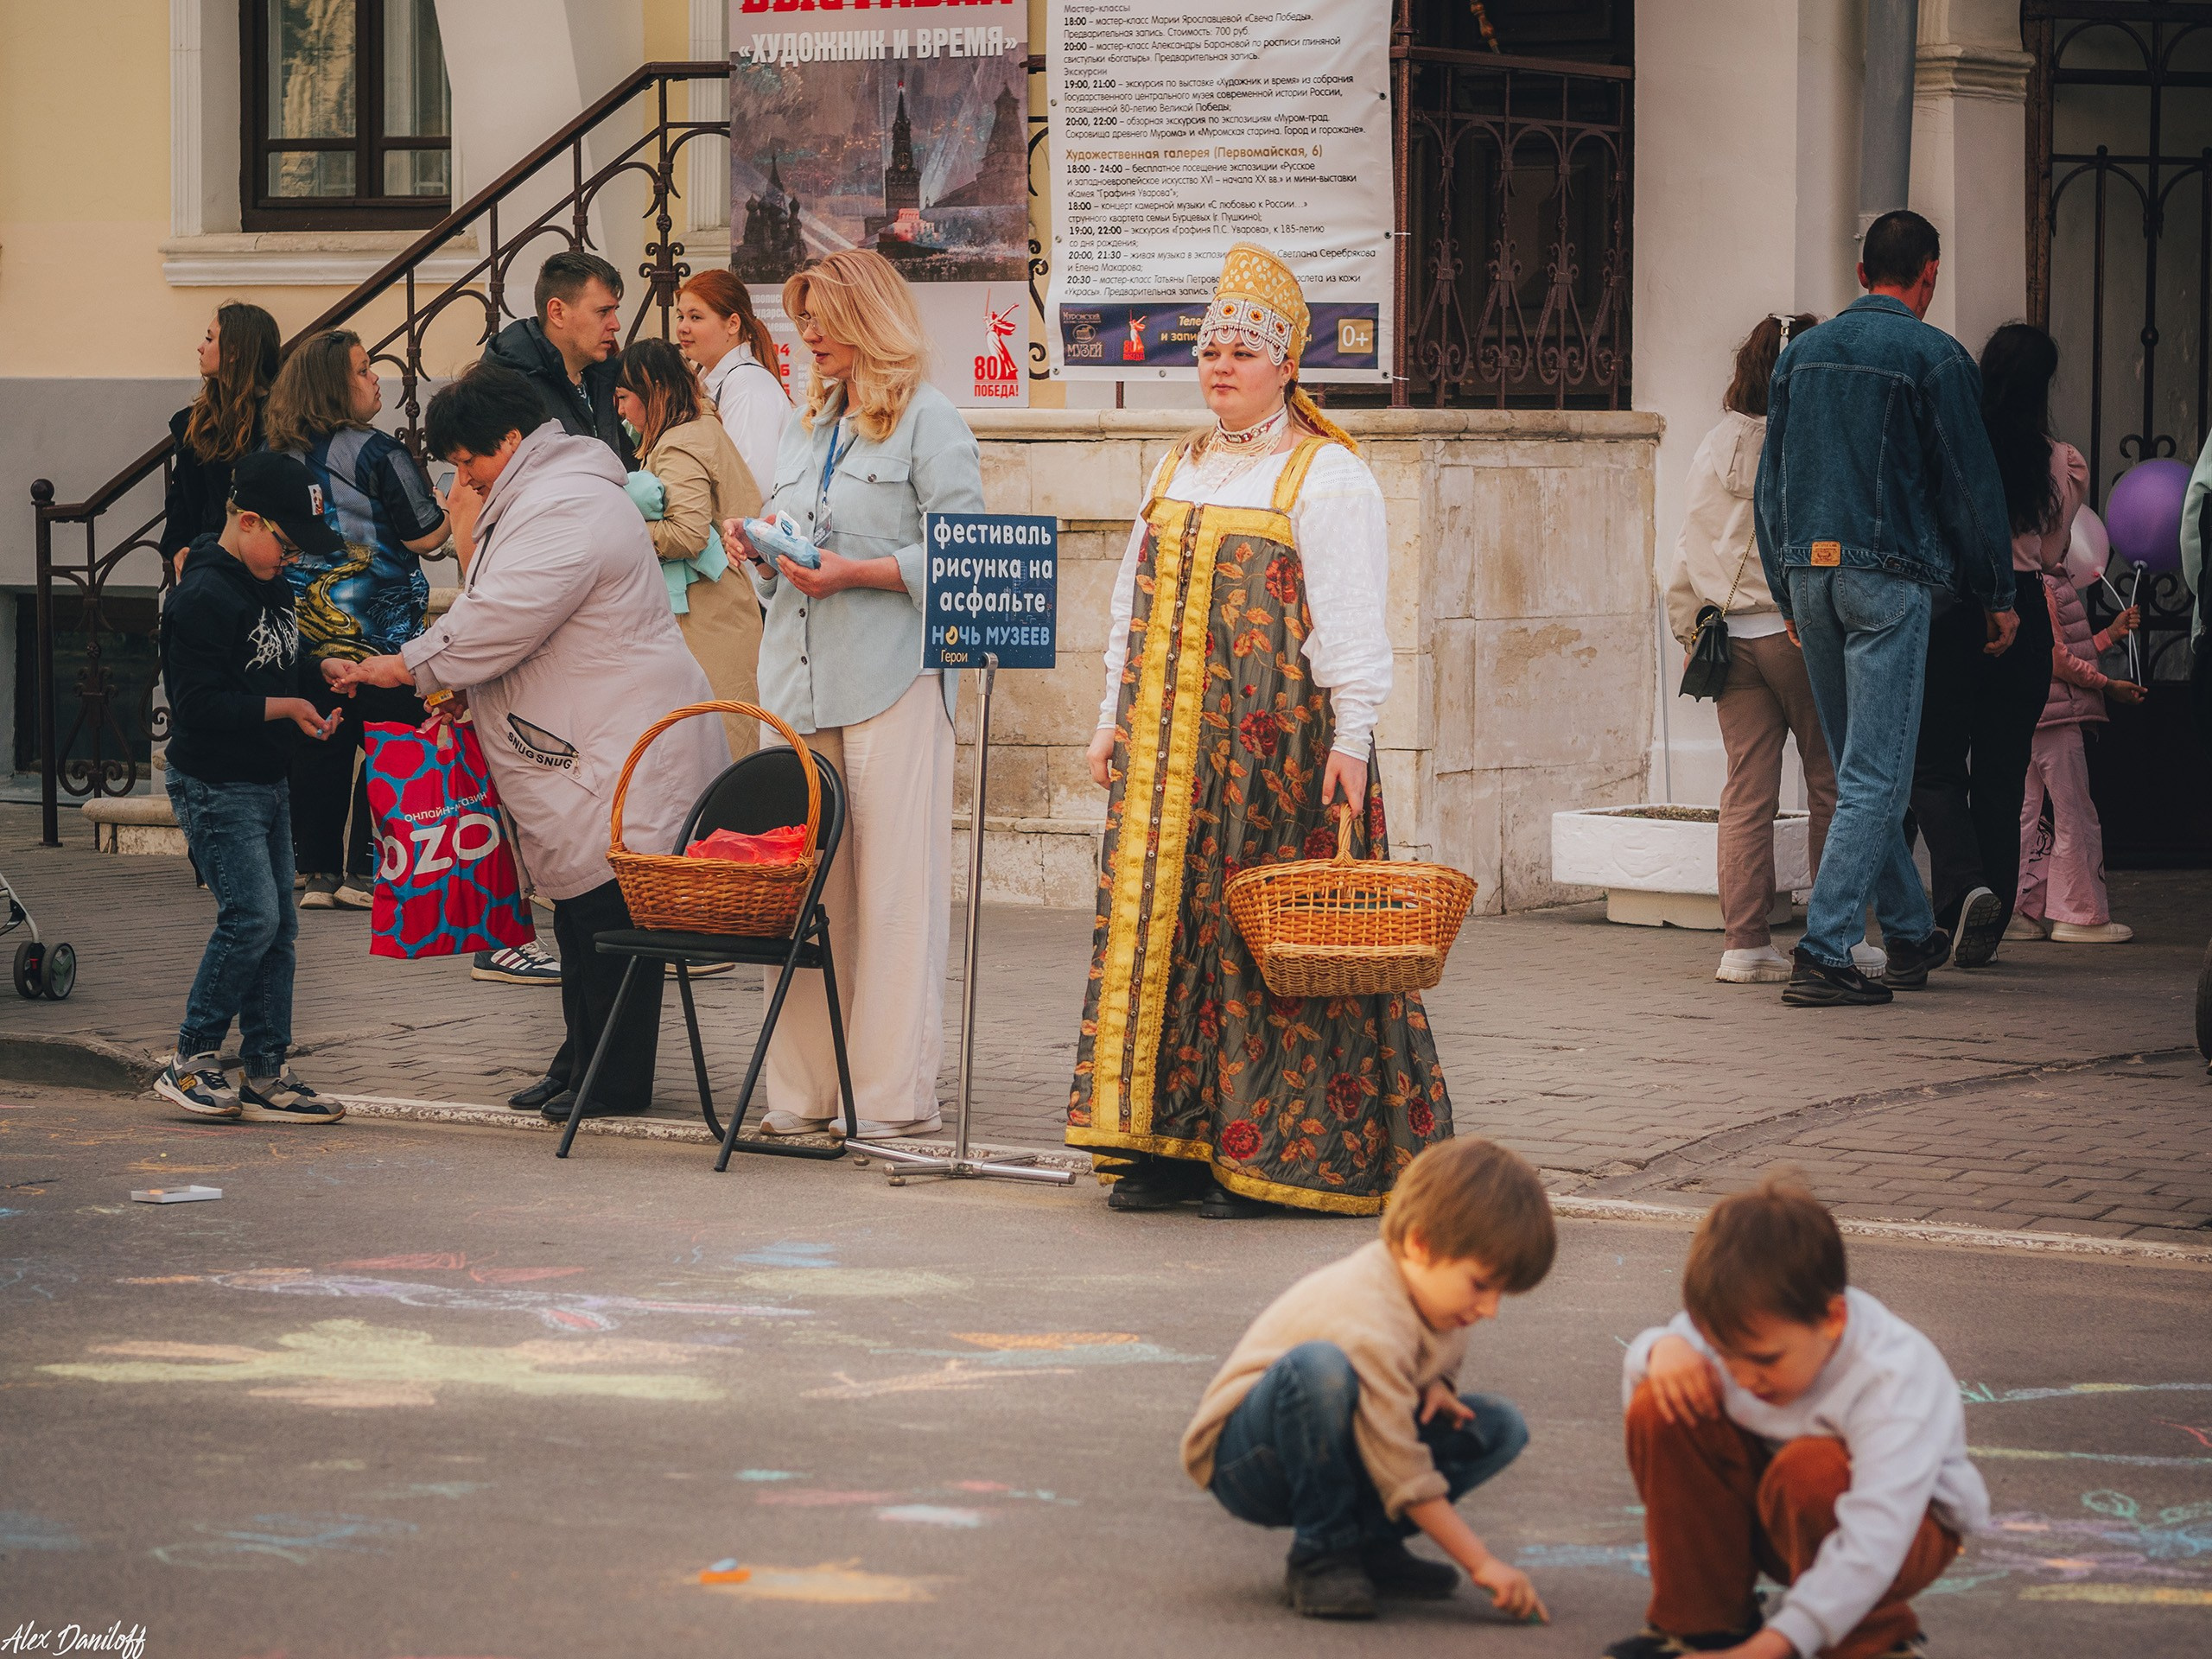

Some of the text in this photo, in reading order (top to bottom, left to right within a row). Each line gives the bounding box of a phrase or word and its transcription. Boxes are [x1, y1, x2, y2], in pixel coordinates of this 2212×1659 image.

[1064, 5, 1130, 15] Мастер-классы
[1065, 12, 1313, 27] 18:00 мастер-класс Марии Ярославцевой «Свеча Победы».
[1065, 29, 1133, 40] Предварительная
[1167, 28, 1212, 36] Стоимость:
[1214, 27, 1231, 35] 700
[1233, 26, 1249, 37] руб.
[738, 26, 1018, 68] «ХУДОЖНИК И ВРЕМЯ»
[1065, 42, 1087, 51] 20:00
[1096, 42, 1149, 52] мастер-класс
[1151, 41, 1201, 50] Александры
[1204, 39, 1249, 50] Барановой
[1263, 40, 1300, 48] росписи
[1064, 56, 1105, 65] свистульки
[1154, 53, 1228, 63] Предварительная
[1064, 67, 1107, 78] Экскурсии
[1065, 80, 1090, 89] 19:00,
[1093, 79, 1116, 88] 21:00
[1126, 80, 1164, 90] экскурсия
[1217, 78, 1262, 88] «Художник
[1272, 78, 1300, 86] время»
[1313, 74, 1353, 86] собрания
[1065, 92, 1133, 103] Государственного
[1135, 92, 1190, 102] центрального
[1192, 92, 1214, 101] музея
[1217, 89, 1273, 100] современной
[1310, 87, 1343, 97] России,
[1065, 102, 1231, 114] посвященной 80-летию Великой Победы;
[1066, 118, 1090, 126] 20:00,
[1093, 117, 1117, 125] 22:00
[1127, 117, 1163, 126] обзорная
[1166, 118, 1206, 126] экскурсия
[1065, 130, 1109, 138] Сокровища
[1112, 130, 1147, 139] древнего
[1150, 129, 1186, 139] Мурома»
[1198, 128, 1244, 137] «Муромская
[1247, 128, 1281, 137] старина.
[1284, 126, 1309, 136] Город
[1319, 126, 1365, 136] горожане».
[1066, 144, 1322, 162] Художественная галерея (Первомайская, 6)
[1100, 164, 1122, 173] 24:00
[1132, 164, 1180, 173] бесплатное
[1281, 162, 1315, 172] «Русское
[1075, 176, 1160, 188] западноевропейское
[1162, 177, 1198, 186] искусство
[1255, 175, 1267, 183] XX
[1068, 189, 1095, 198] «Камея
[1100, 203, 1133, 212] концерт
[1135, 201, 1174, 212] камерной
[1177, 202, 1205, 211] музыки
[1219, 200, 1256, 208] любовью
[1068, 215, 1108, 225] струнного
[1109, 215, 1144, 224] квартета
[1173, 213, 1211, 224] Бурцевых
[1070, 226, 1095, 236] 19:00,
[1131, 227, 1169, 236] экскурсия
[1173, 226, 1211, 236] «Графиня
[1213, 225, 1229, 233] П.С.
[1231, 226, 1271, 235] Уварова»,
[1281, 225, 1325, 233] 185-летию
[1096, 240, 1138, 249] рождения;
[1069, 251, 1094, 260] 20:00,
[1097, 251, 1121, 259] 21:30
[1157, 252, 1185, 261] музыка
[1319, 248, 1376, 259] Серебрякова
[1075, 263, 1099, 271] Елена
[1101, 264, 1143, 273] Макарова;
[1099, 276, 1152, 285] мастер-класс
[1154, 275, 1184, 283] Татьяны
[1186, 275, 1221, 285] Петрово
[1104, 287, 1176, 297] Предварительная
[1160, 333, 1198, 341] и запи
[1342, 325, 1370, 347] 0+
[1067, 341, 1103, 358] МУЗЕЙ
[974, 355, 998, 380] 80
[974, 385, 1019, 398] ПОБЕДА!
[933, 516, 1052, 550] фестиваль
[932, 557, 1052, 585] рисунка на
[939, 585, 1046, 619] асфальте
[931, 626, 1050, 645] НОЧЬ МУЗЕЕВ
[940, 650, 969, 665] Герои
[508, 732, 573, 770] SNUG SNUG
